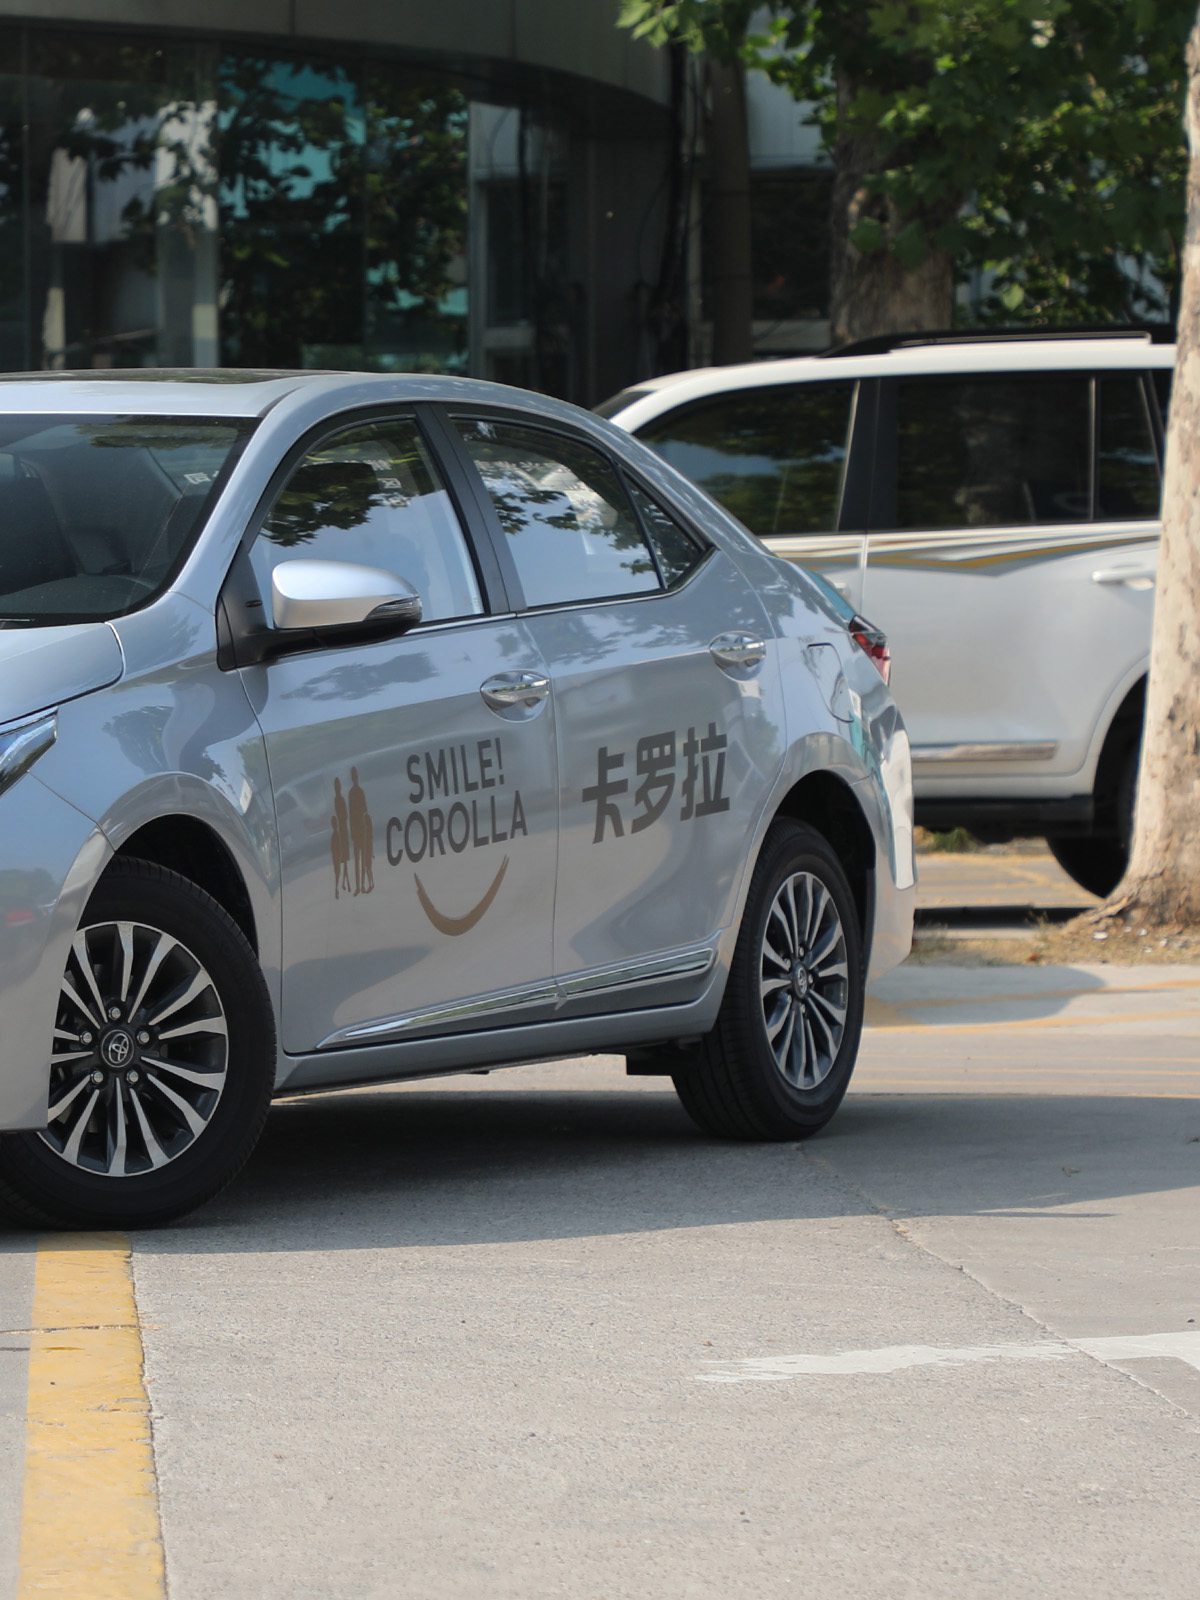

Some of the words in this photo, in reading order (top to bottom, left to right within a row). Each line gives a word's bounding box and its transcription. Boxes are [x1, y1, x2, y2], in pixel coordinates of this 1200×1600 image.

[406, 737, 506, 804] SMILE!
[581, 722, 731, 844] 卡罗拉
[386, 790, 529, 867] COROLLA
